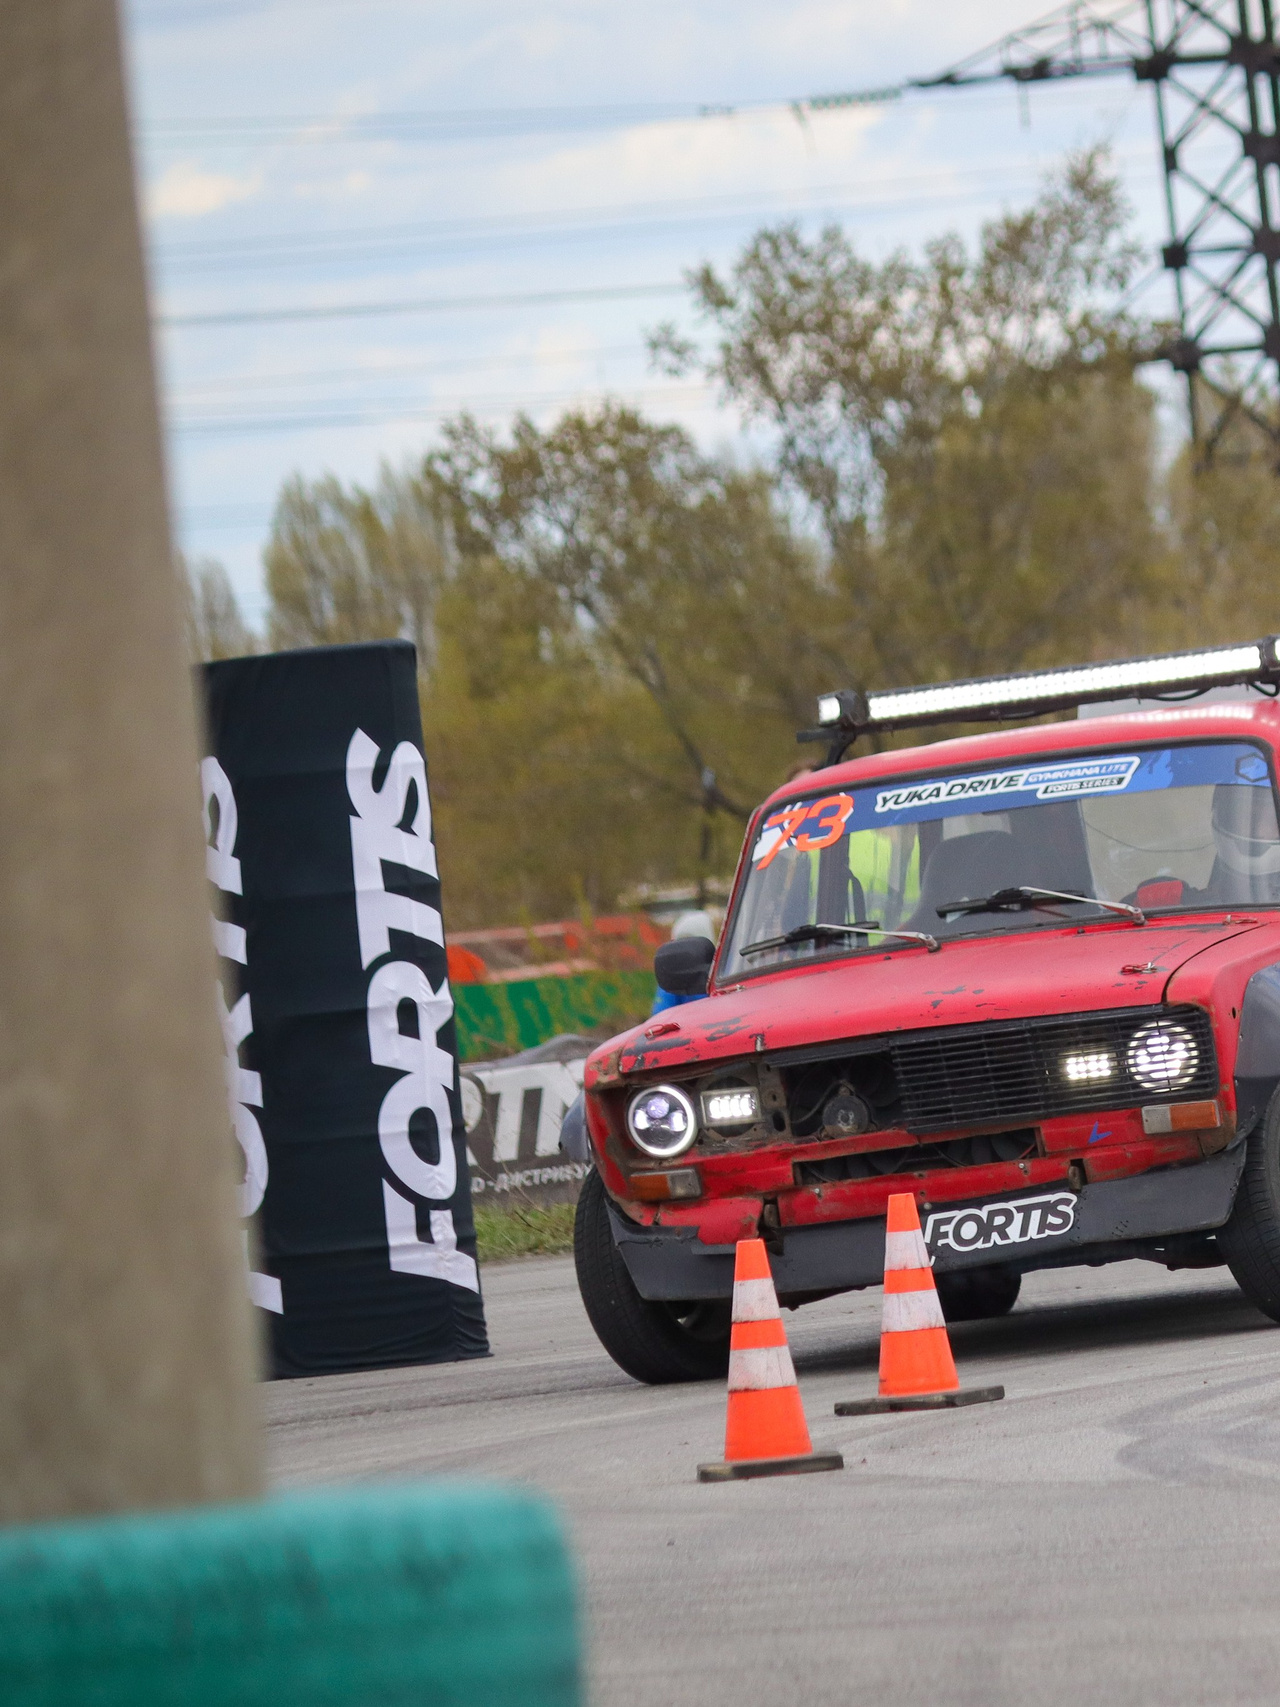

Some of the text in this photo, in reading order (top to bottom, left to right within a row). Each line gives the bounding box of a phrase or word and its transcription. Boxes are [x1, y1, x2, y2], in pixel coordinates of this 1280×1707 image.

[881, 773, 1024, 809] YUKA DRIVE
[1028, 763, 1128, 782] GYMKHANA LITE
[1081, 777, 1120, 790] SERIES
[757, 794, 854, 871] 73
[346, 728, 480, 1294] FORTIS
[926, 1197, 1075, 1249] FORTIS
